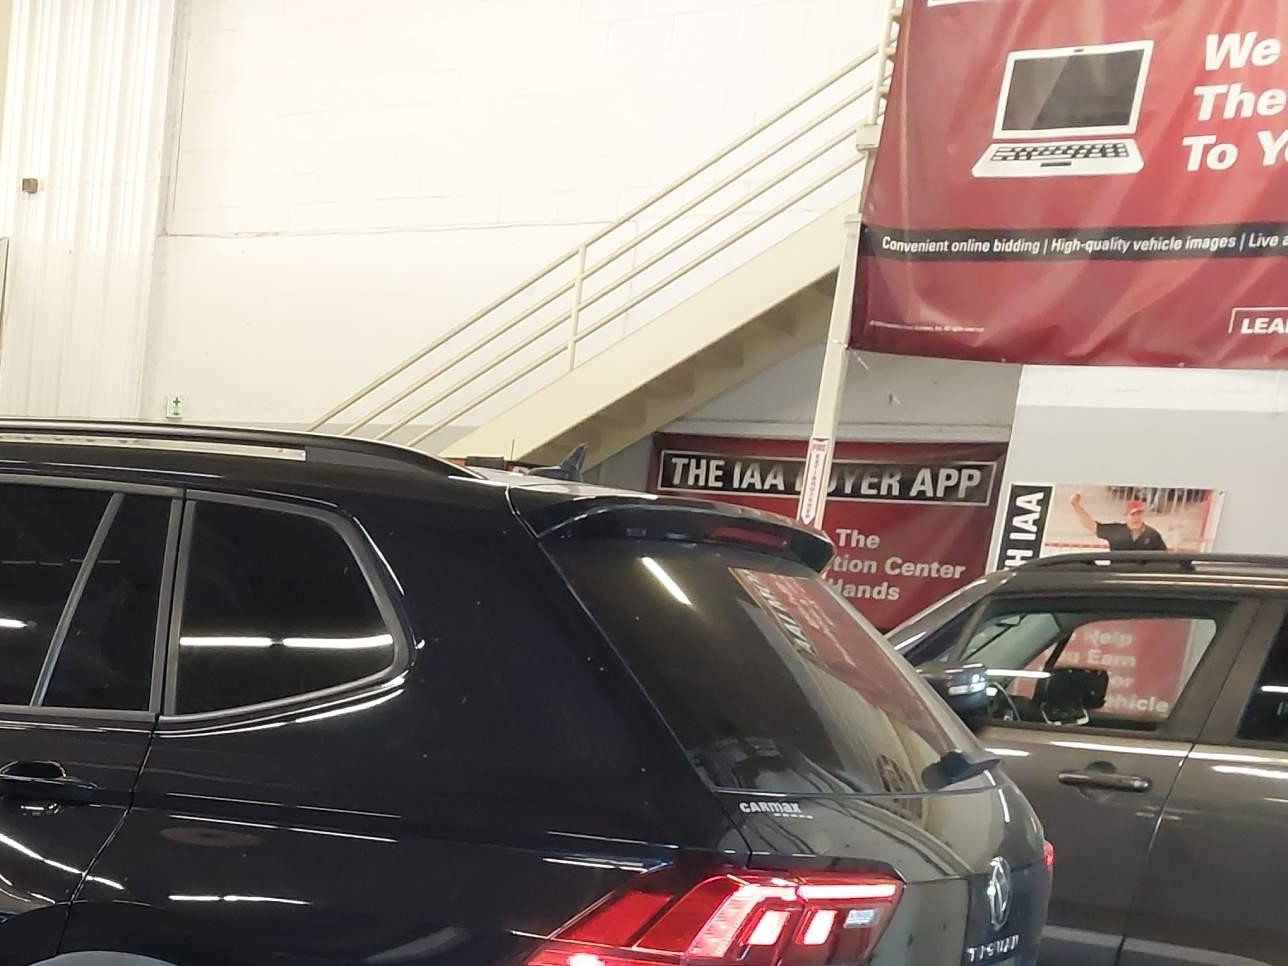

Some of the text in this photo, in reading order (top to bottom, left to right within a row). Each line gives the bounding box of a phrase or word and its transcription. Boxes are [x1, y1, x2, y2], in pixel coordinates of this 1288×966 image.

[1204, 31, 1281, 71] We
[1193, 82, 1287, 121] The
[1182, 129, 1288, 172] To Y
[881, 236, 949, 253] Convenient
[951, 238, 991, 253] online
[993, 238, 1041, 255] bidding
[1051, 237, 1130, 255] High-quality
[1133, 236, 1182, 251] vehicle
[1185, 235, 1237, 252] images
[1248, 232, 1279, 248] Live
[1240, 317, 1288, 335] LEA
[671, 457, 725, 488] THE
[732, 461, 785, 491] IAA
[909, 467, 982, 498] APP
[1009, 491, 1045, 541] IAA
[835, 528, 881, 549] The
[833, 554, 966, 579] tion Center
